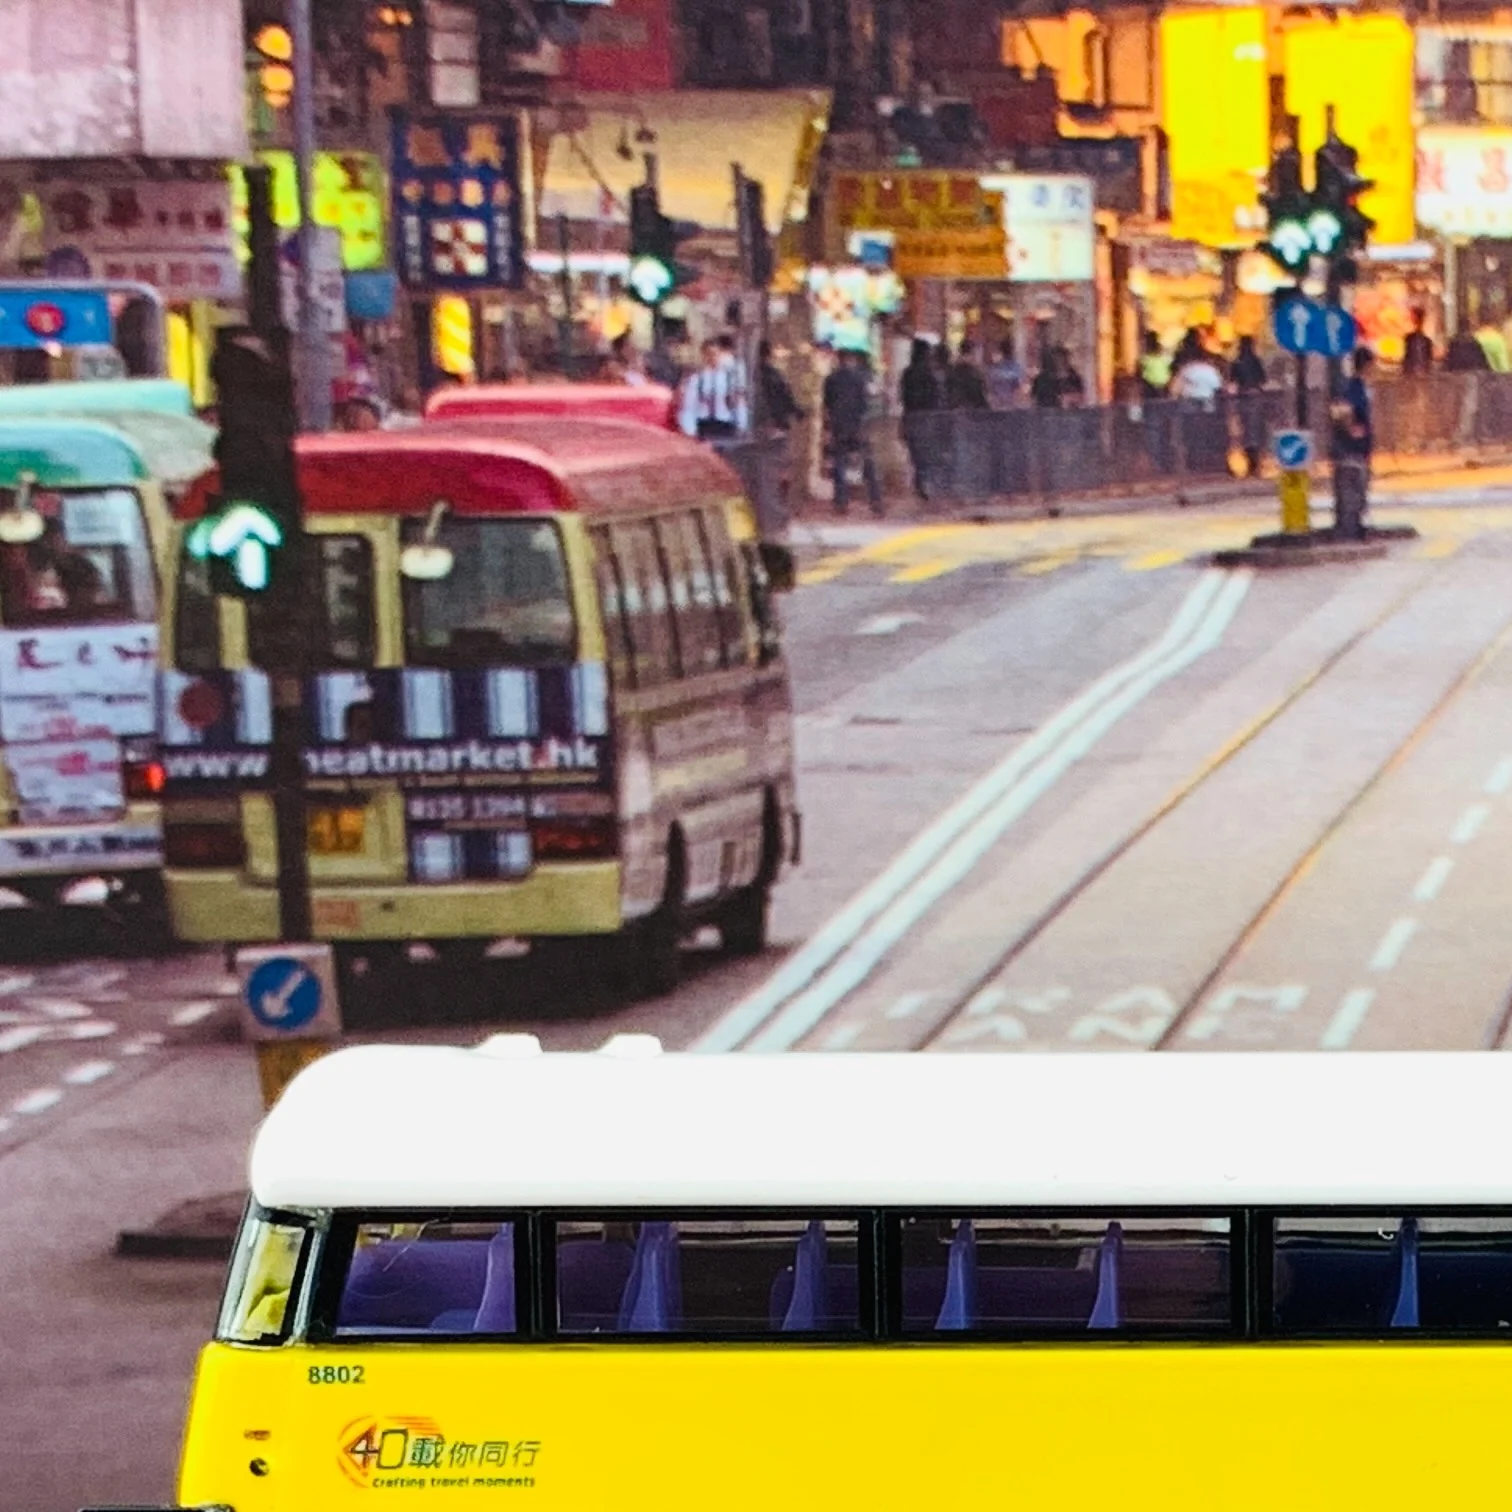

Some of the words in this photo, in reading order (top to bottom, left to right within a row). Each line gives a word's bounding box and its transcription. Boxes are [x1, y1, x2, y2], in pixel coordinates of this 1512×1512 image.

[308, 1366, 366, 1384] 8802
[372, 1477, 425, 1488] Crafting
[431, 1477, 469, 1487] travel
[473, 1477, 536, 1488] moments
